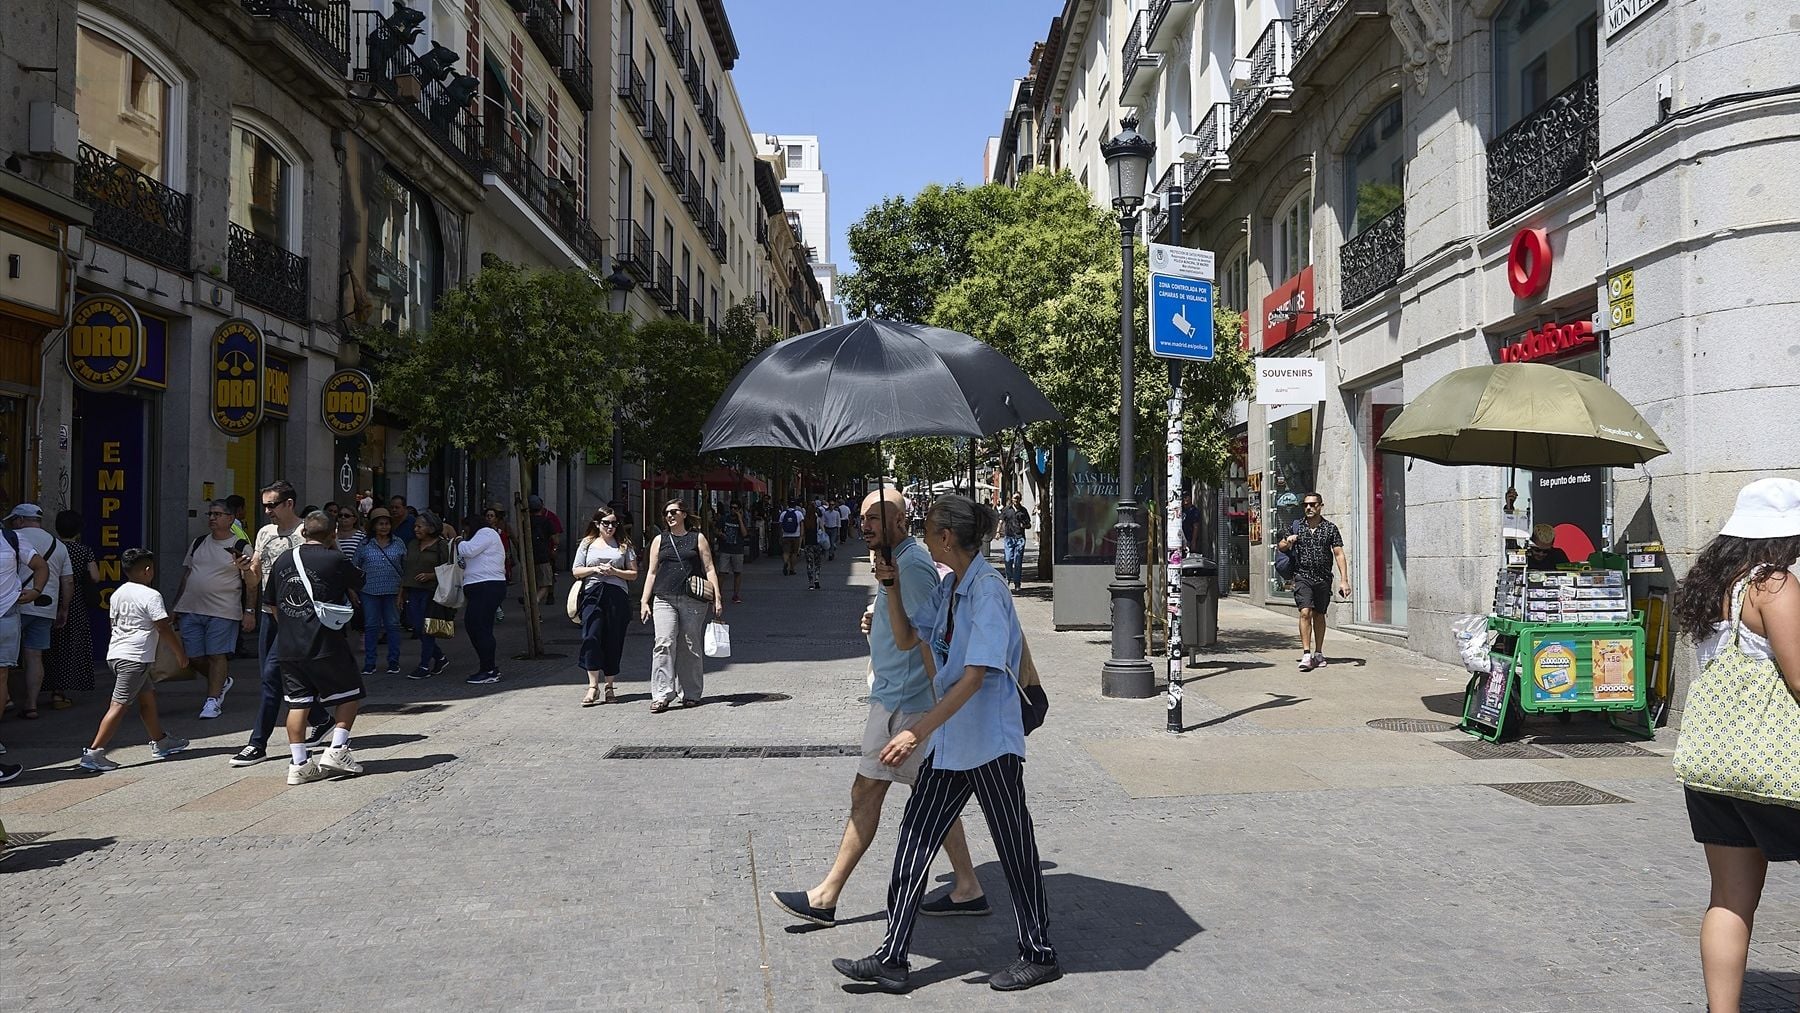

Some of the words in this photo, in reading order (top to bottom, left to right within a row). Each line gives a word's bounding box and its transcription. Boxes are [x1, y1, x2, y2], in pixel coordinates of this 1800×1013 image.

[1172, 283, 1198, 293] CONTROLADA
[1186, 294, 1207, 302] VIGILANCIA
[76, 302, 127, 325] COMPRO
[72, 326, 131, 356] ORO
[218, 325, 256, 344] COMPRO
[1499, 321, 1594, 363] vodafone
[74, 359, 128, 382] EMPEÑO
[1262, 369, 1313, 377] SOUVENIRS
[330, 376, 364, 390] COMPRO
[217, 379, 256, 408] ORO
[327, 391, 366, 413] ORO
[1072, 470, 1097, 483] MÁS
[1540, 478, 1549, 487] Ese
[1550, 477, 1567, 488] punto
[1568, 475, 1576, 484] de
[1577, 473, 1591, 483] más
[1075, 485, 1084, 494] Y
